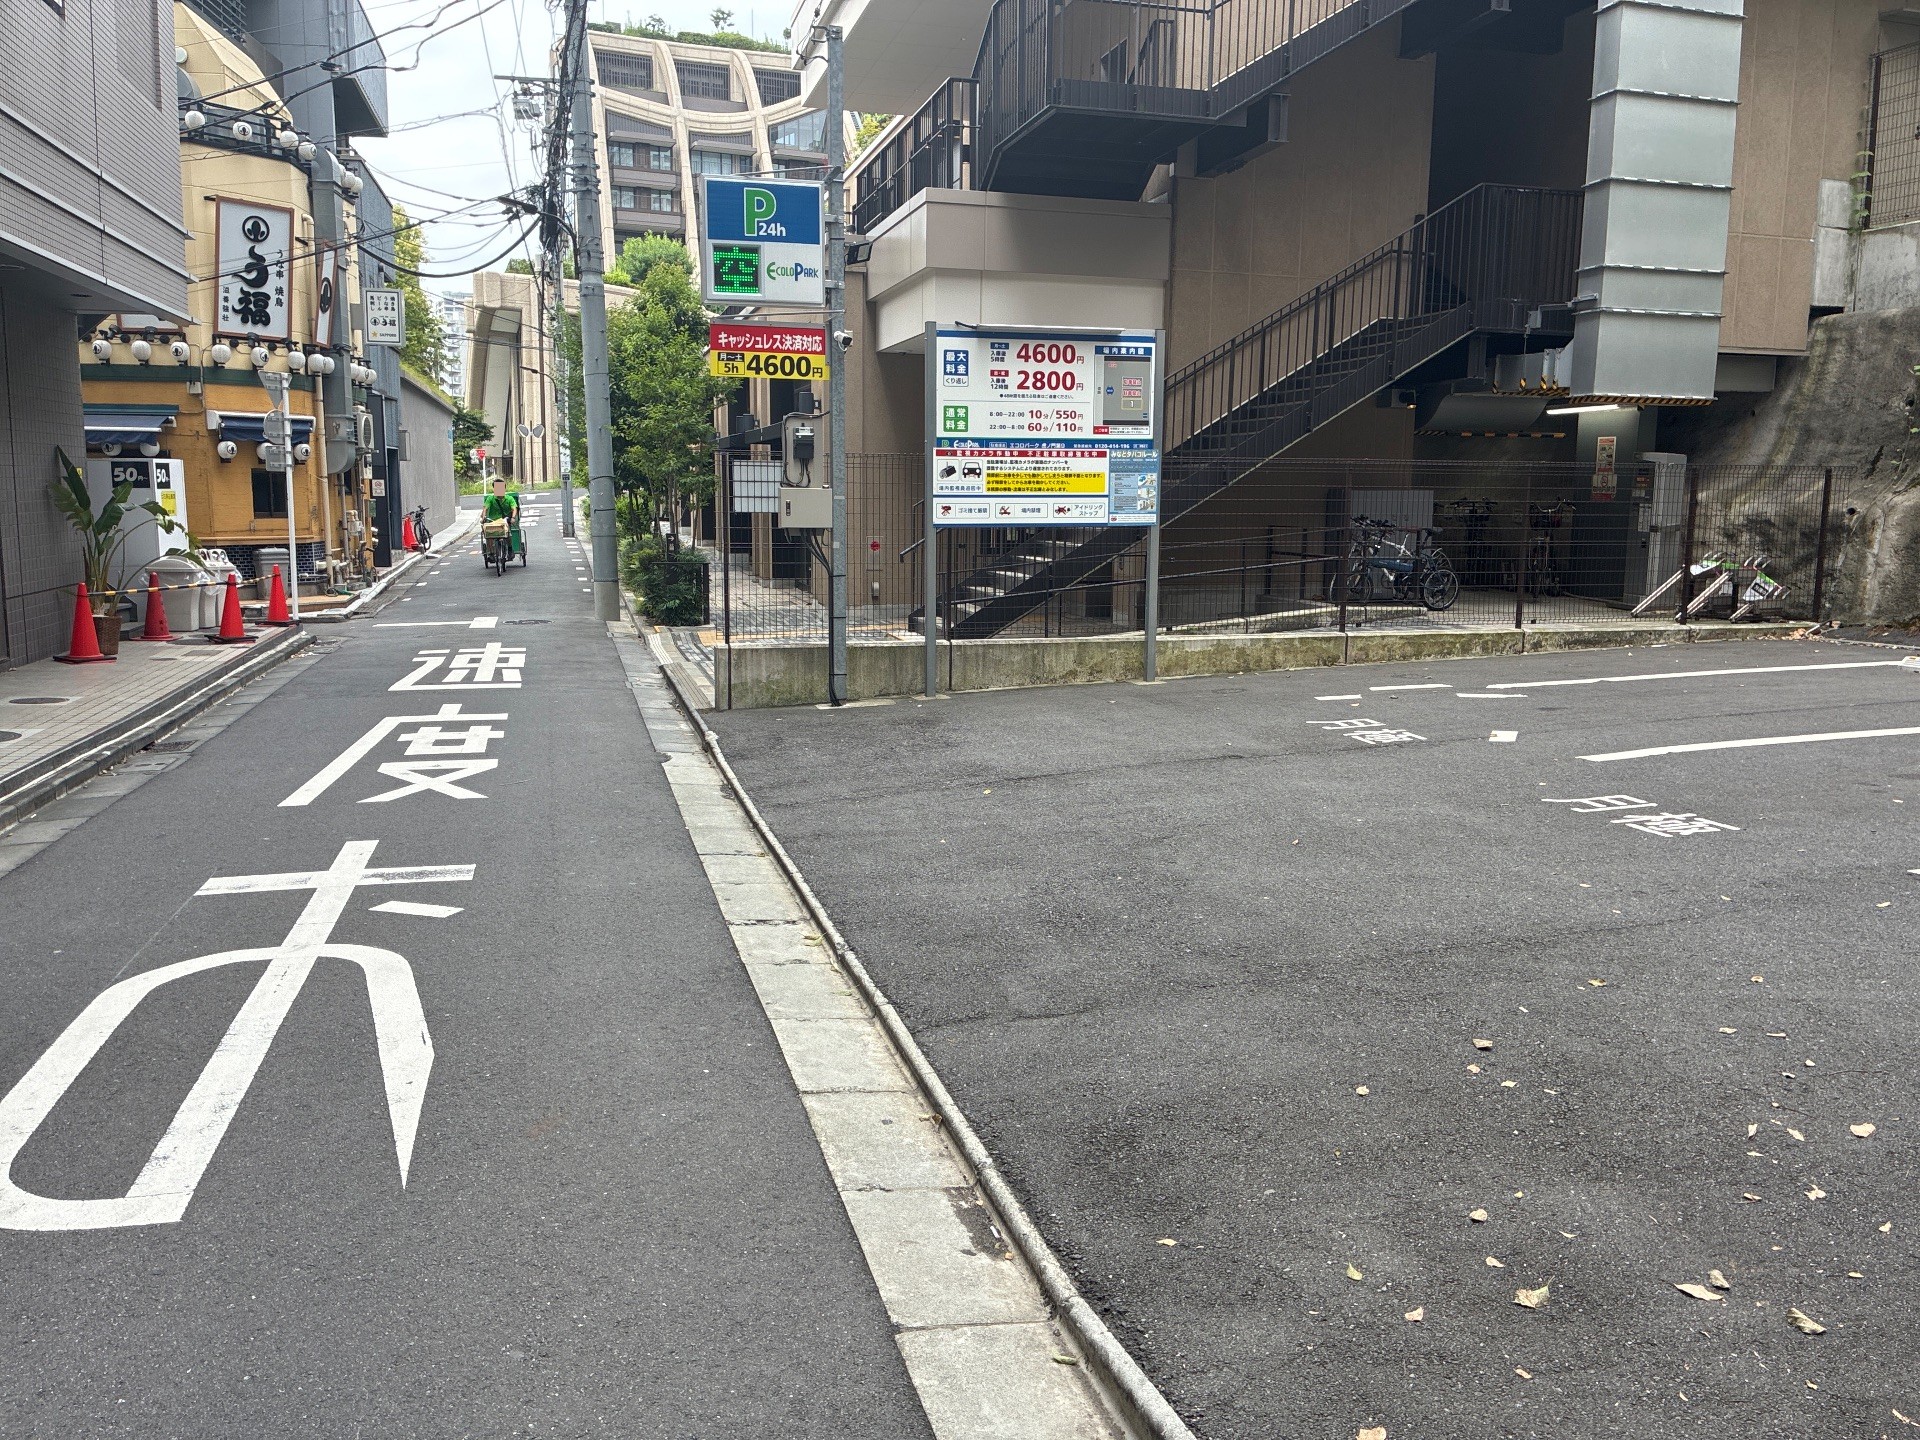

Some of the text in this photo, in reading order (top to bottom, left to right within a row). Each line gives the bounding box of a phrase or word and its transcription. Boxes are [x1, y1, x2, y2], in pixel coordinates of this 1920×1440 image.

[744, 187, 787, 237] P 24h
[713, 246, 759, 293] 空
[274, 286, 284, 308] 焼鳥
[718, 332, 823, 352] キャッシュレス決済対応
[945, 351, 967, 362] 最大
[1016, 343, 1085, 365] 4600円
[724, 362, 739, 374] 5h
[746, 354, 823, 378] 4600円
[945, 364, 967, 375] 料金
[944, 377, 967, 385] くり返し
[1016, 370, 1084, 392] 2800円
[945, 407, 967, 418] 通常
[945, 420, 967, 430] 料金
[1306, 718, 1427, 745] 月極
[1541, 794, 1740, 838] 月極
